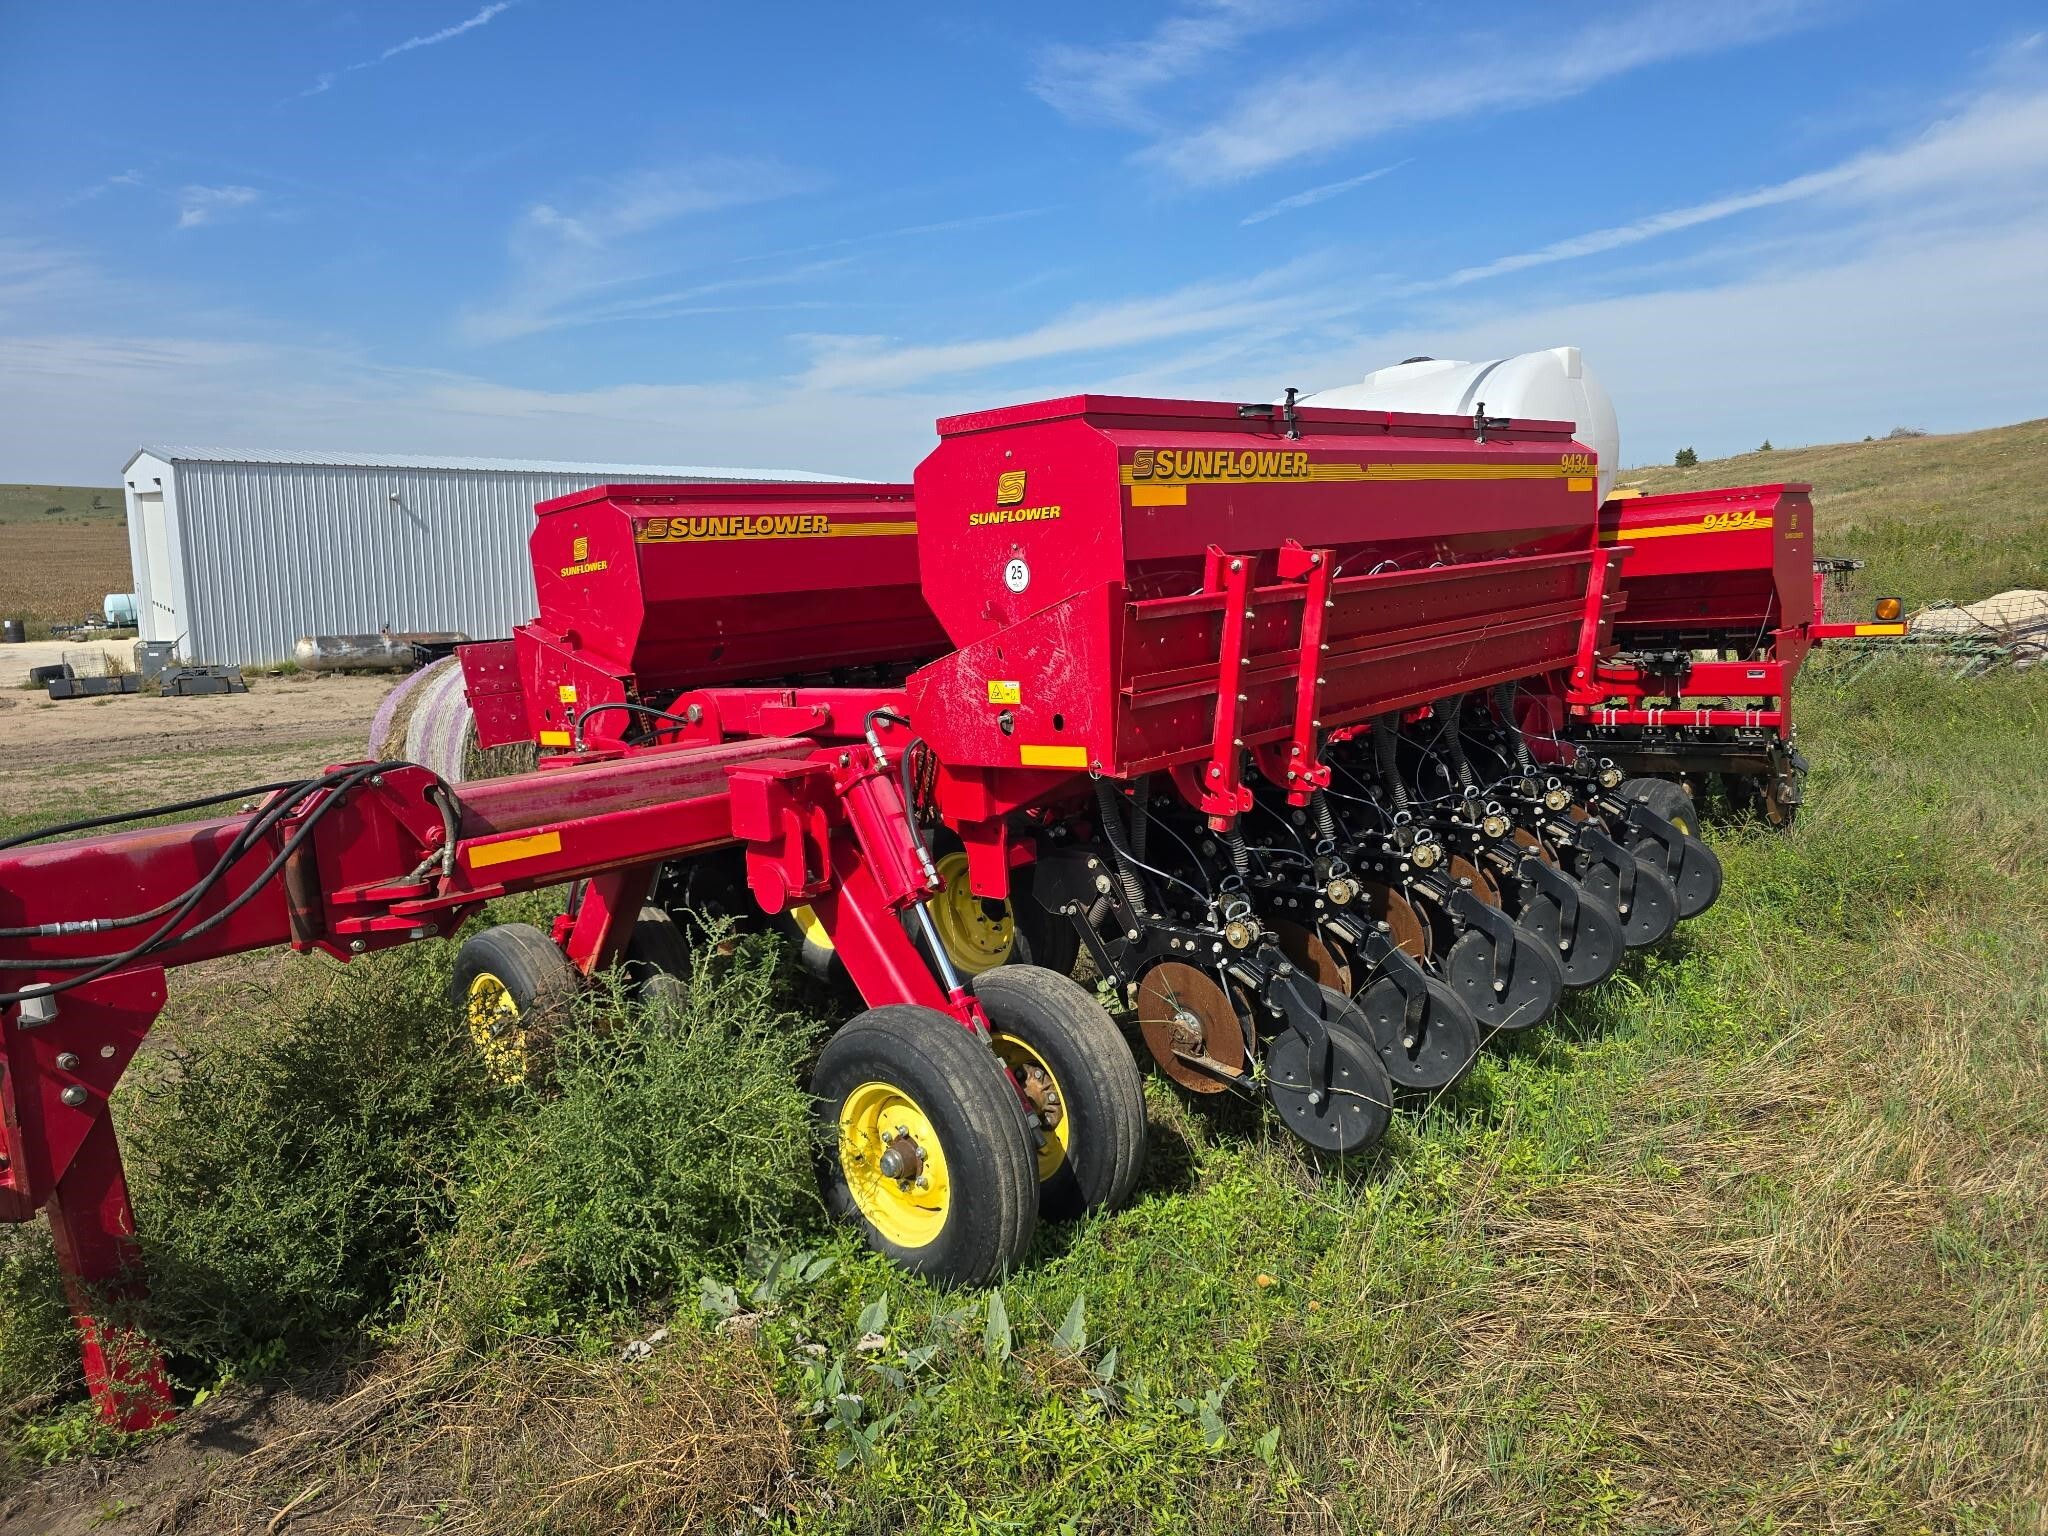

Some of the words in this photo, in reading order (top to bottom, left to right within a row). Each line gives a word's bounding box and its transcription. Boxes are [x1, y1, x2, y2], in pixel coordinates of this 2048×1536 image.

[1154, 450, 1309, 479] SUNFLOWER
[1561, 453, 1589, 473] 9434
[969, 505, 1061, 526] SUNFLOWER
[1703, 511, 1757, 530] 9434
[670, 515, 829, 538] SUNFLOWER
[561, 561, 607, 577] SUNFLOWER
[1011, 565, 1023, 580] 25
